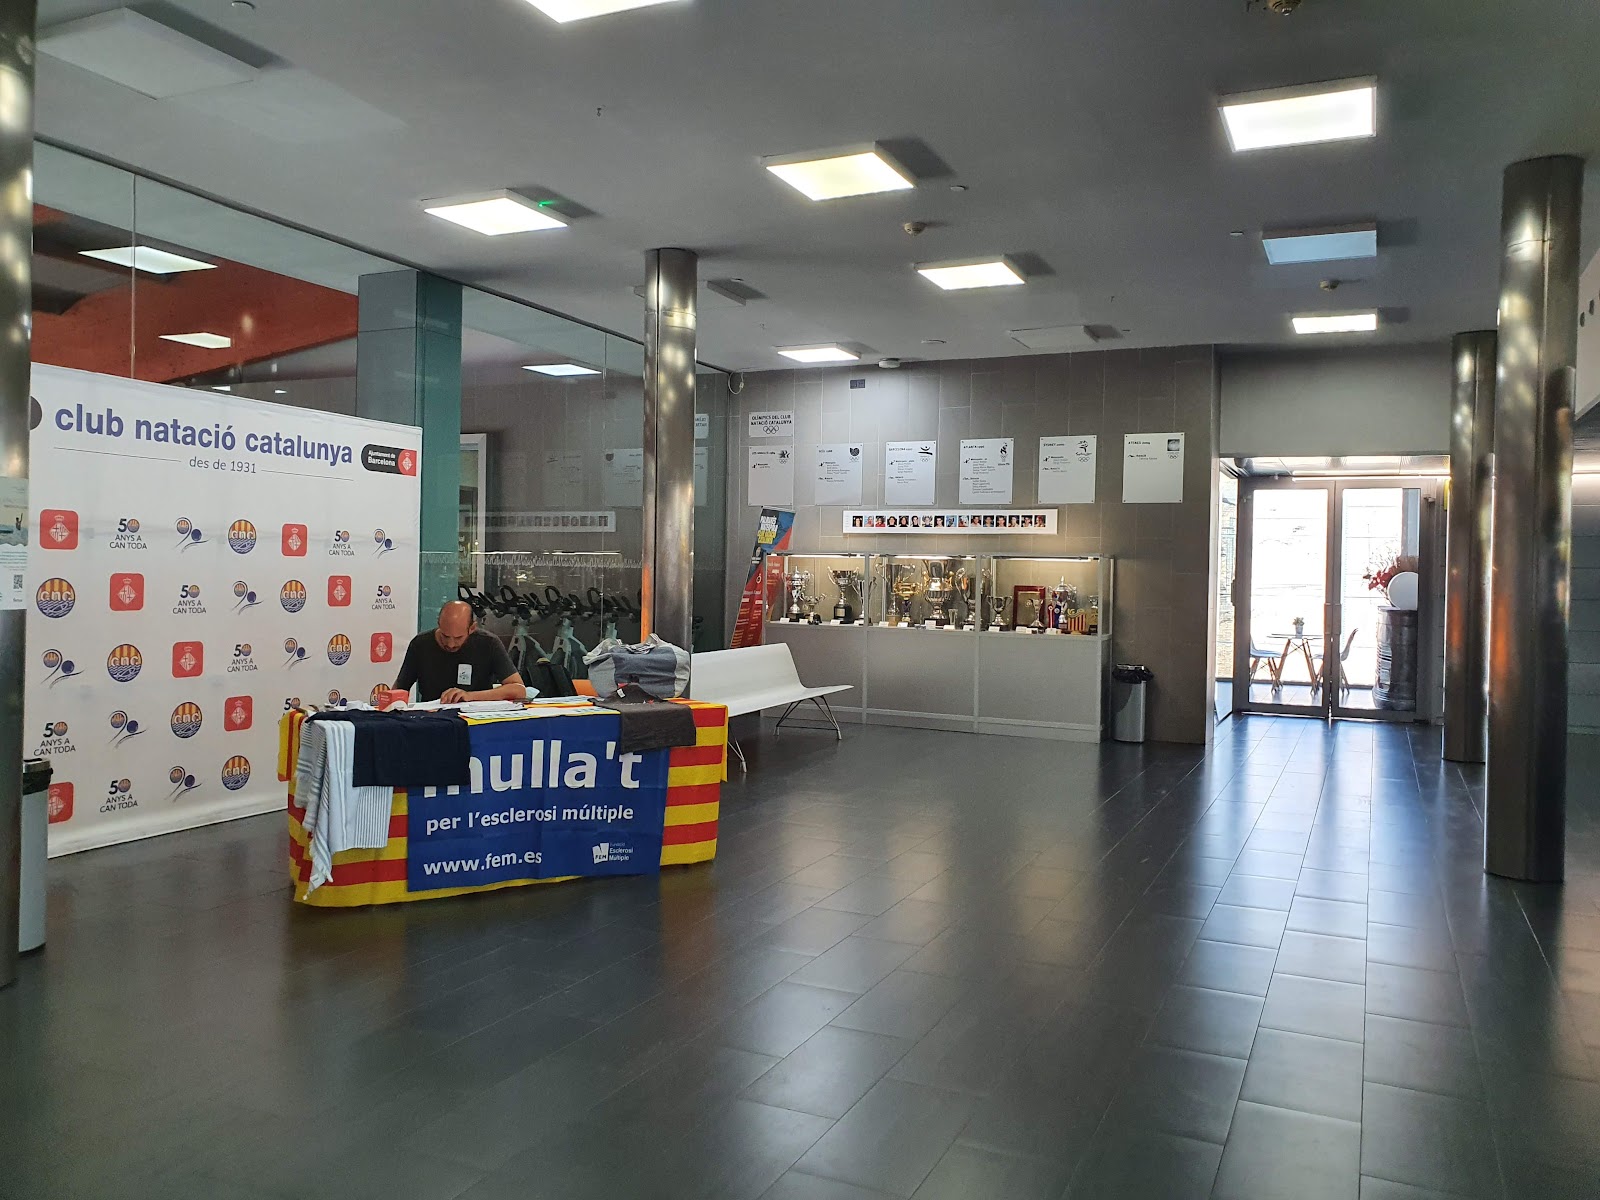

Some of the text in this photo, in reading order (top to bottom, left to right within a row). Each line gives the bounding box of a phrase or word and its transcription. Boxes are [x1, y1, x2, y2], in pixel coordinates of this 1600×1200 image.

[55, 403, 353, 466] club natació catalunya
[368, 450, 390, 459] Ajuntament
[189, 456, 257, 474] des de 1931
[367, 456, 396, 467] Barcelona
[115, 534, 135, 542] ANYS
[109, 541, 148, 550] CAN TODA
[40, 739, 63, 748] ANYS
[33, 745, 76, 757] CAN TODA
[105, 796, 127, 804] ANYS
[100, 800, 138, 813] CAN TODA
[426, 804, 634, 836] per l'esclerosi múltiple
[423, 850, 542, 876] www.fem.es
